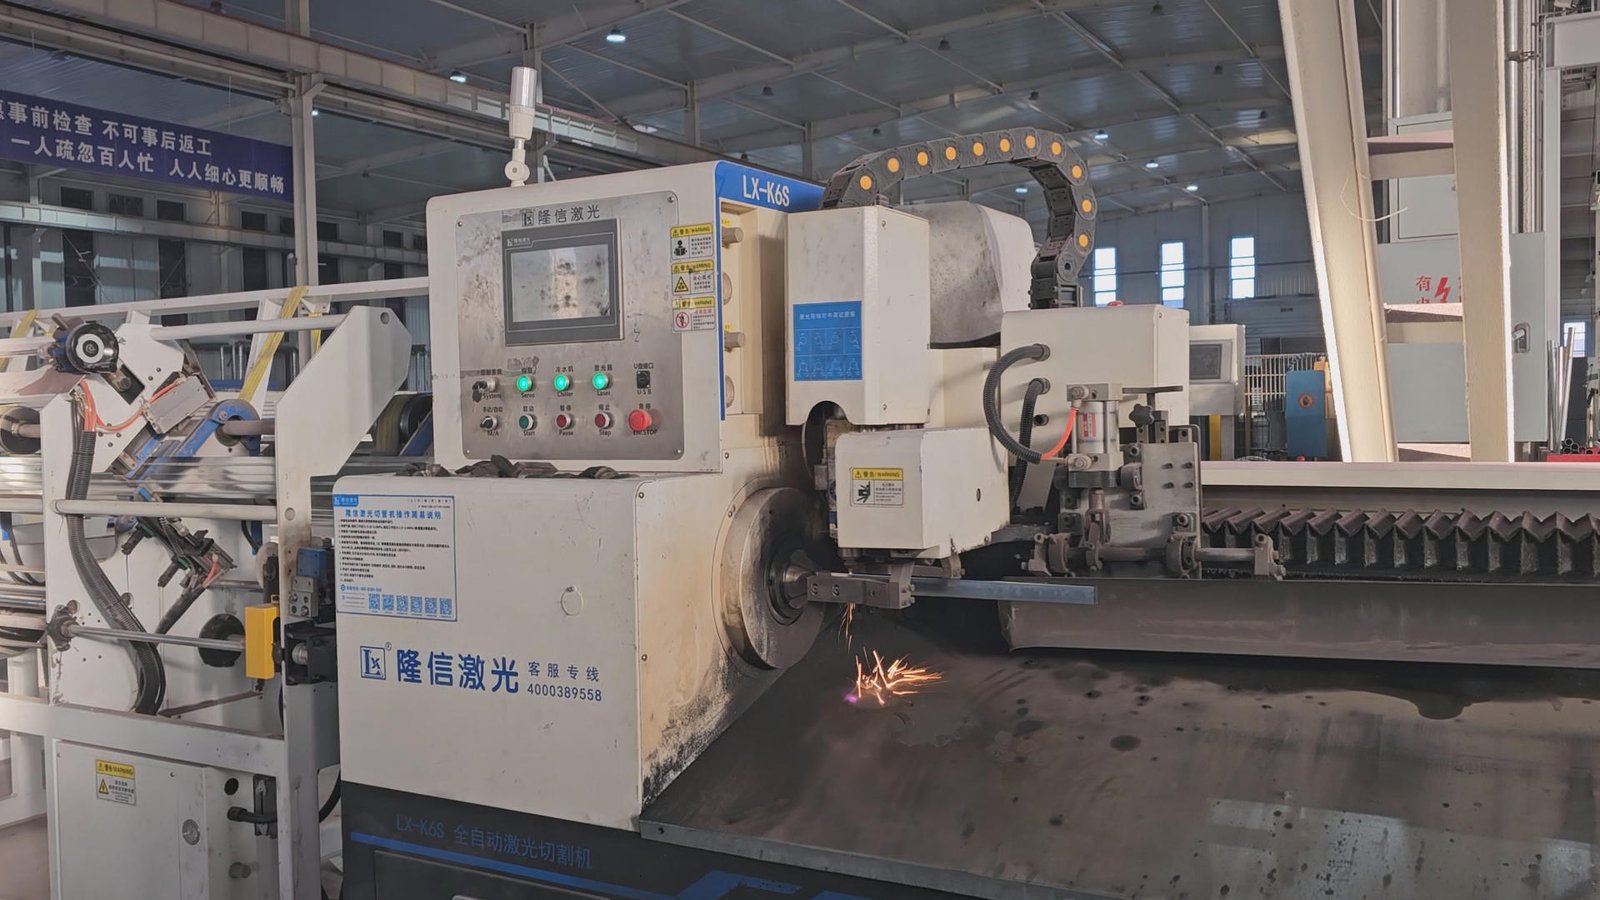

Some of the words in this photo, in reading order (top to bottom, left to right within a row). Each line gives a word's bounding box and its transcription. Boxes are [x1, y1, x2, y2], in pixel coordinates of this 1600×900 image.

[102, 119, 212, 156] 不可事后返工
[11, 135, 155, 173] 一人疏忽百人忙
[169, 158, 285, 195] 人人细心更顺畅
[743, 175, 790, 207] LX-K6S
[538, 204, 600, 225] 隆信激光
[555, 365, 574, 373] 冷水机
[599, 429, 611, 437] Stop
[397, 648, 519, 693] 隆信激光
[528, 661, 600, 683] 客服专线
[527, 683, 603, 702] 4000389558
[396, 815, 445, 839] LX-K6S
[454, 824, 592, 870] 全自动激光切割机
